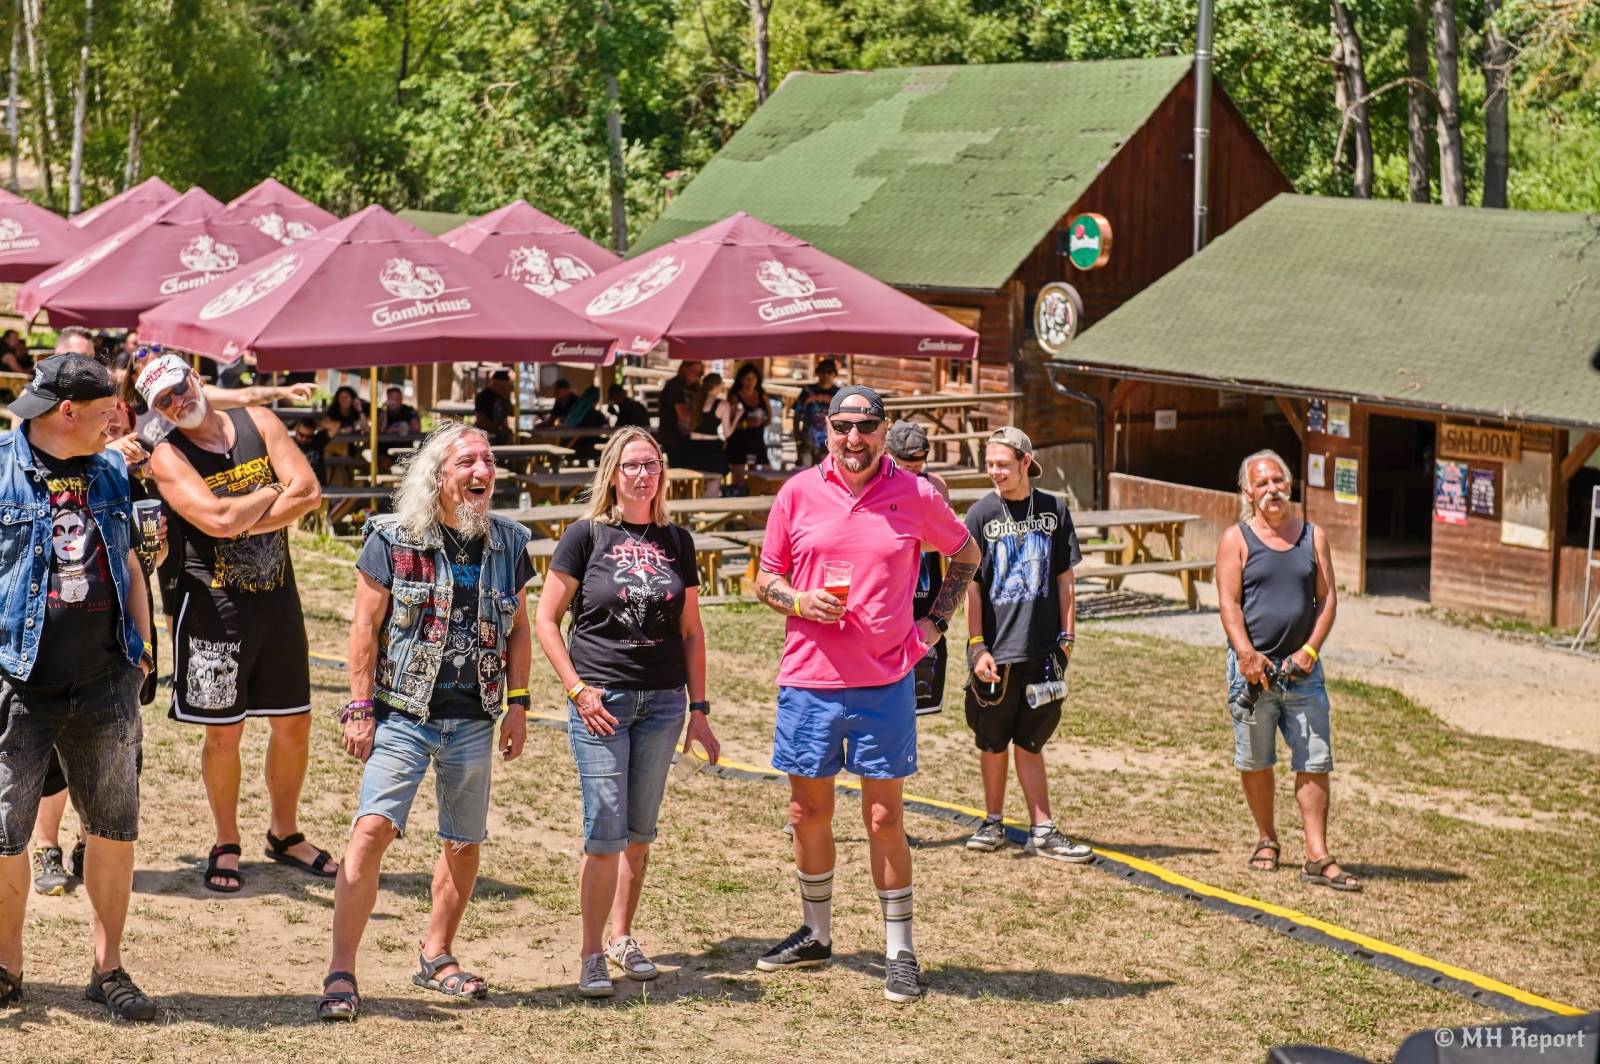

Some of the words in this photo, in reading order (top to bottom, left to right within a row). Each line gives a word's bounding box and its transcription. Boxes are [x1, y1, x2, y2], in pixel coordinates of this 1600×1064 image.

[371, 297, 472, 327] Gambrinus
[758, 296, 843, 322] Gambrinus
[1446, 428, 1513, 458] SALOON
[203, 455, 269, 491] ESTROY
